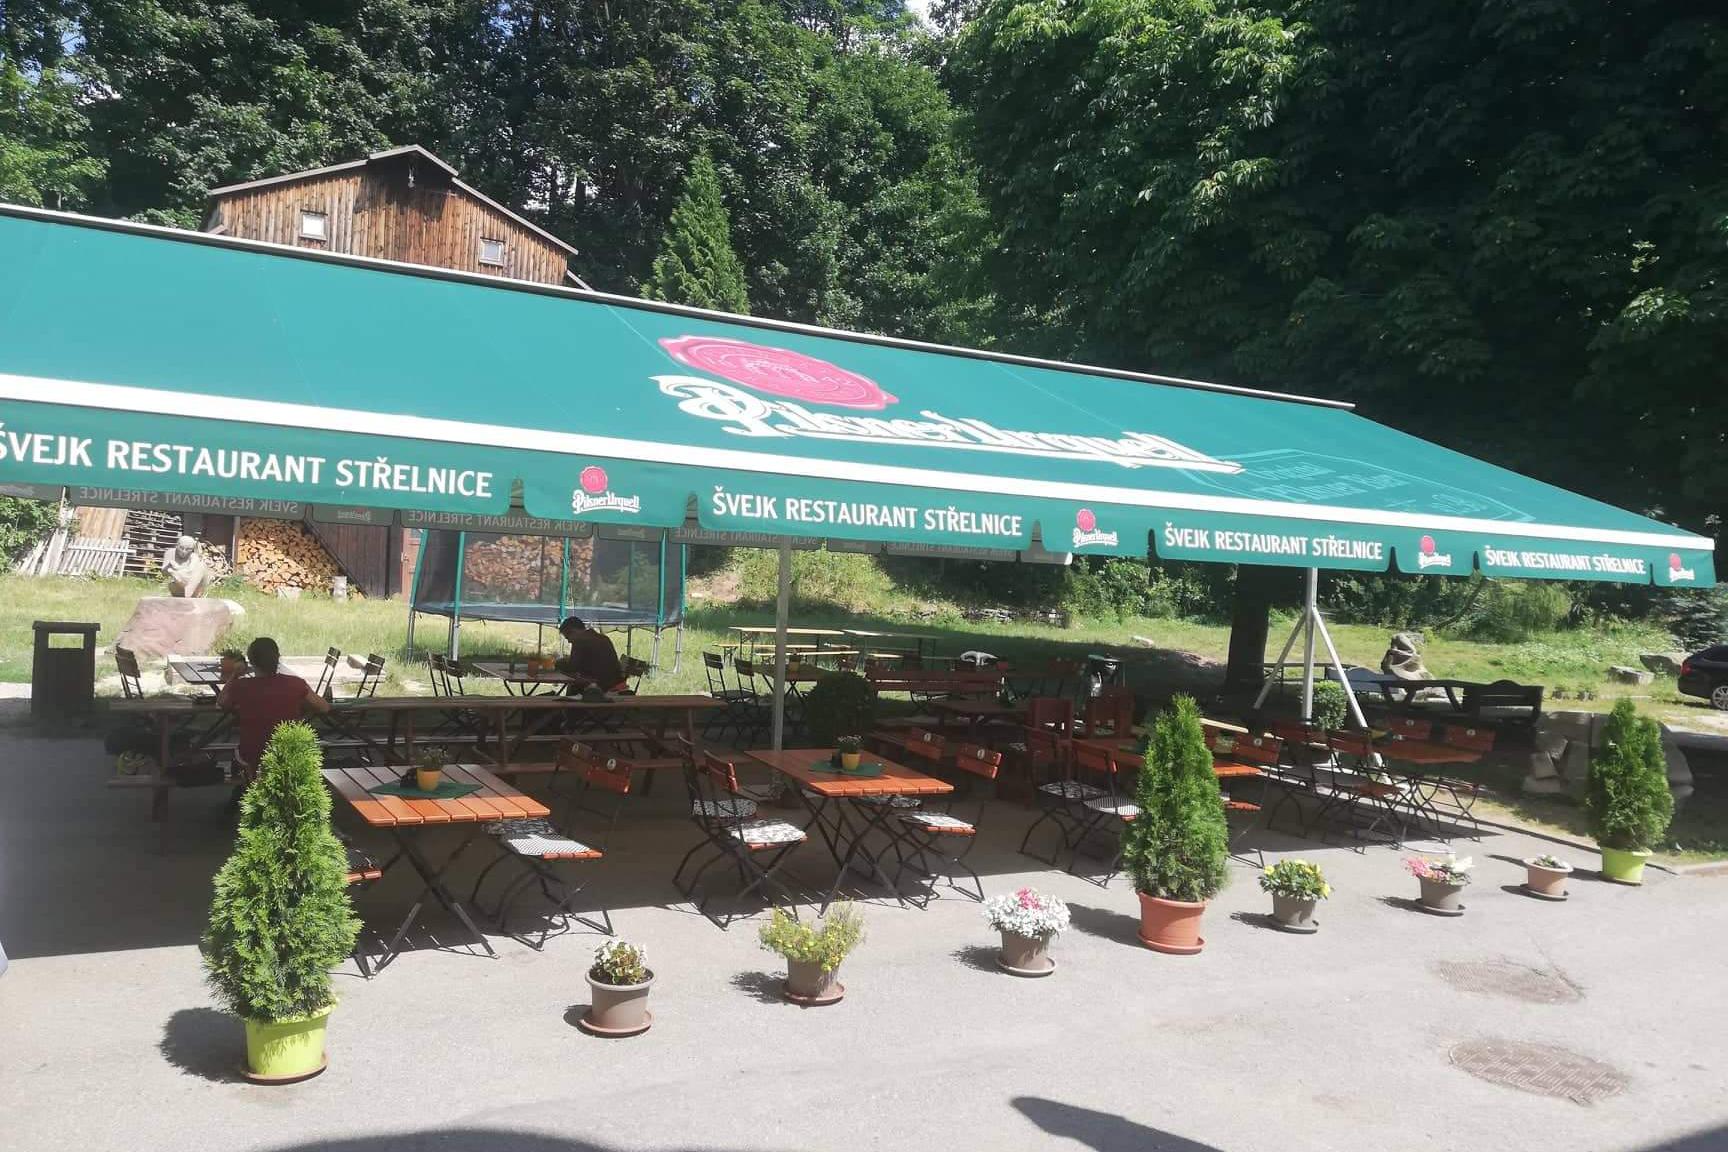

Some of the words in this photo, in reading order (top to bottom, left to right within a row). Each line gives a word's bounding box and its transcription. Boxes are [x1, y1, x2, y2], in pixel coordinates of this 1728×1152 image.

[107, 440, 326, 484] RESTAURANT
[336, 456, 493, 498] STŘELNICE
[572, 489, 608, 514] Pilsner
[606, 491, 642, 513] Urquell
[712, 486, 778, 519] ŠVEJK
[786, 498, 918, 528] RESTAURANT
[924, 506, 1023, 536] STŘELNICE
[1164, 522, 1210, 549] ŠVEJK
[1215, 530, 1308, 555] RESTAURANT
[1312, 535, 1383, 560] STŘELNICE
[1522, 551, 1594, 571] RESTAURANT
